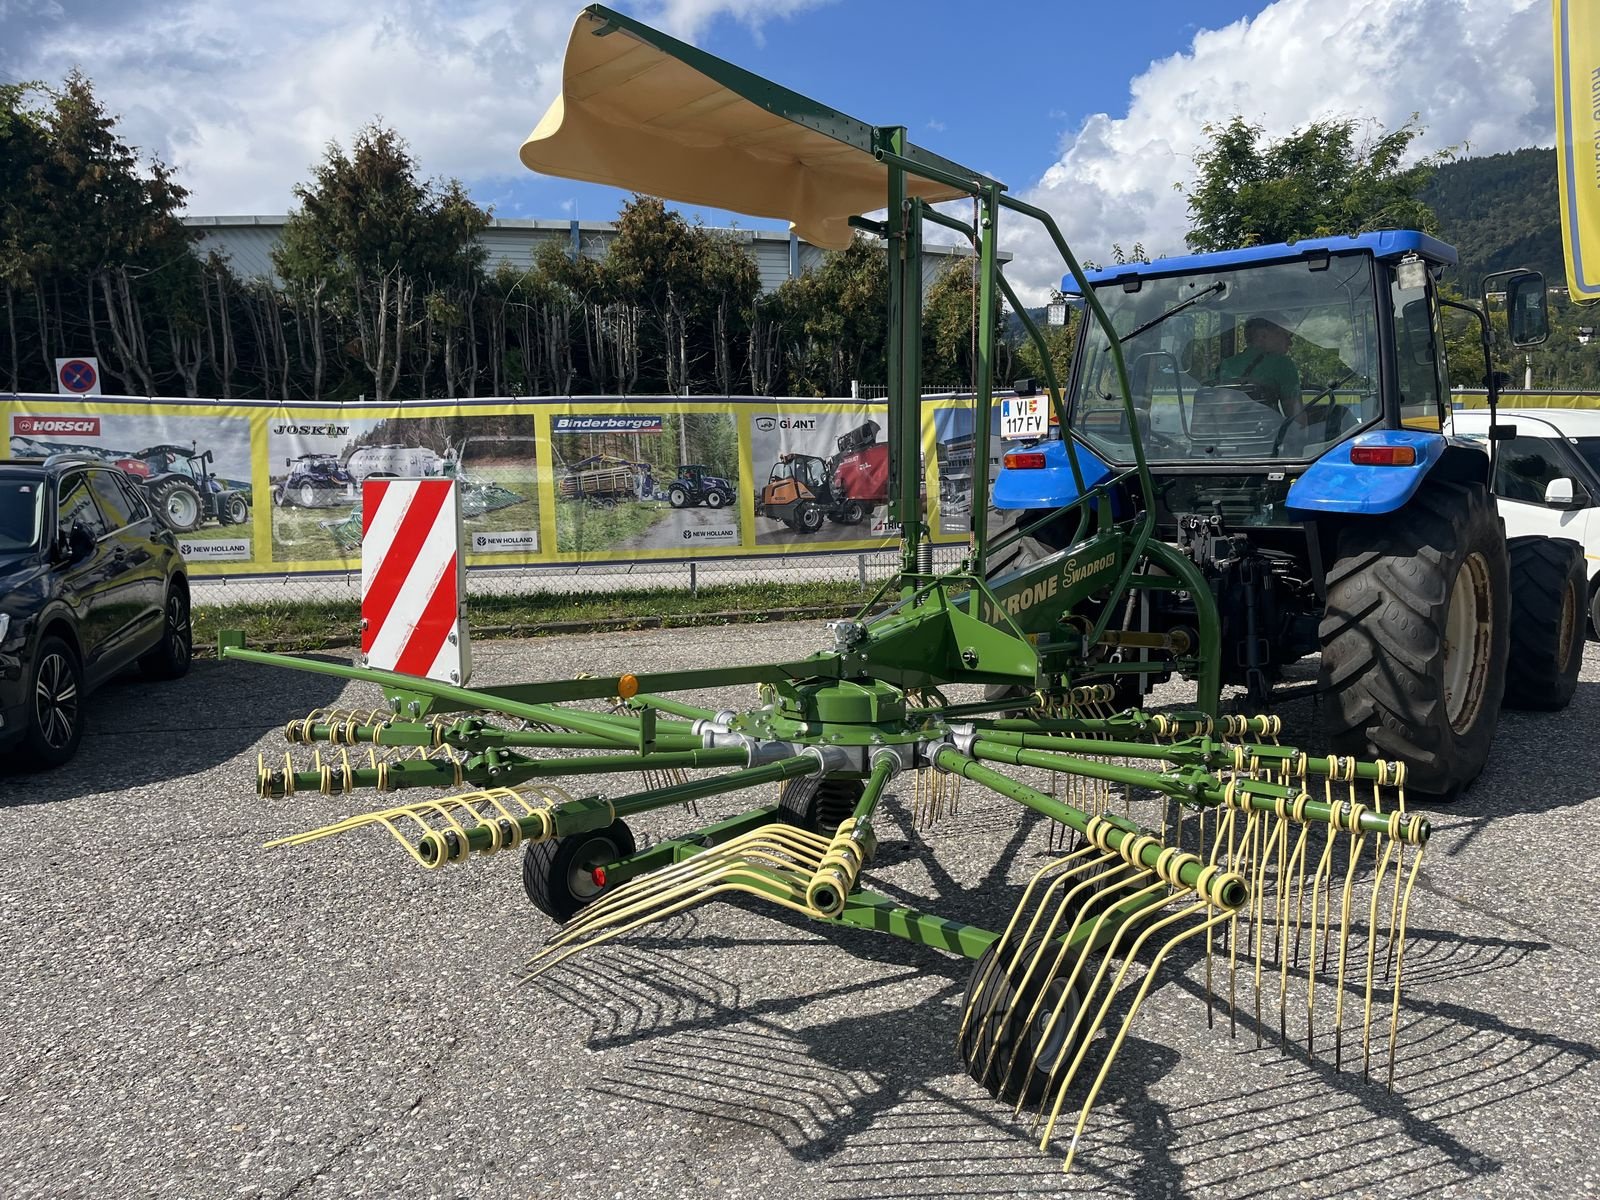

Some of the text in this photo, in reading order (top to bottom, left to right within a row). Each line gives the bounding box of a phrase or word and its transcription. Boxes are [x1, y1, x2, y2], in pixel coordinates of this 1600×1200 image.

[1016, 400, 1027, 416] VI
[32, 421, 95, 432] HORSCH
[273, 424, 350, 437] JOSKIN
[557, 418, 660, 429] Binderberger
[1007, 415, 1042, 433] 117 FV
[992, 574, 1059, 624] KRONE
